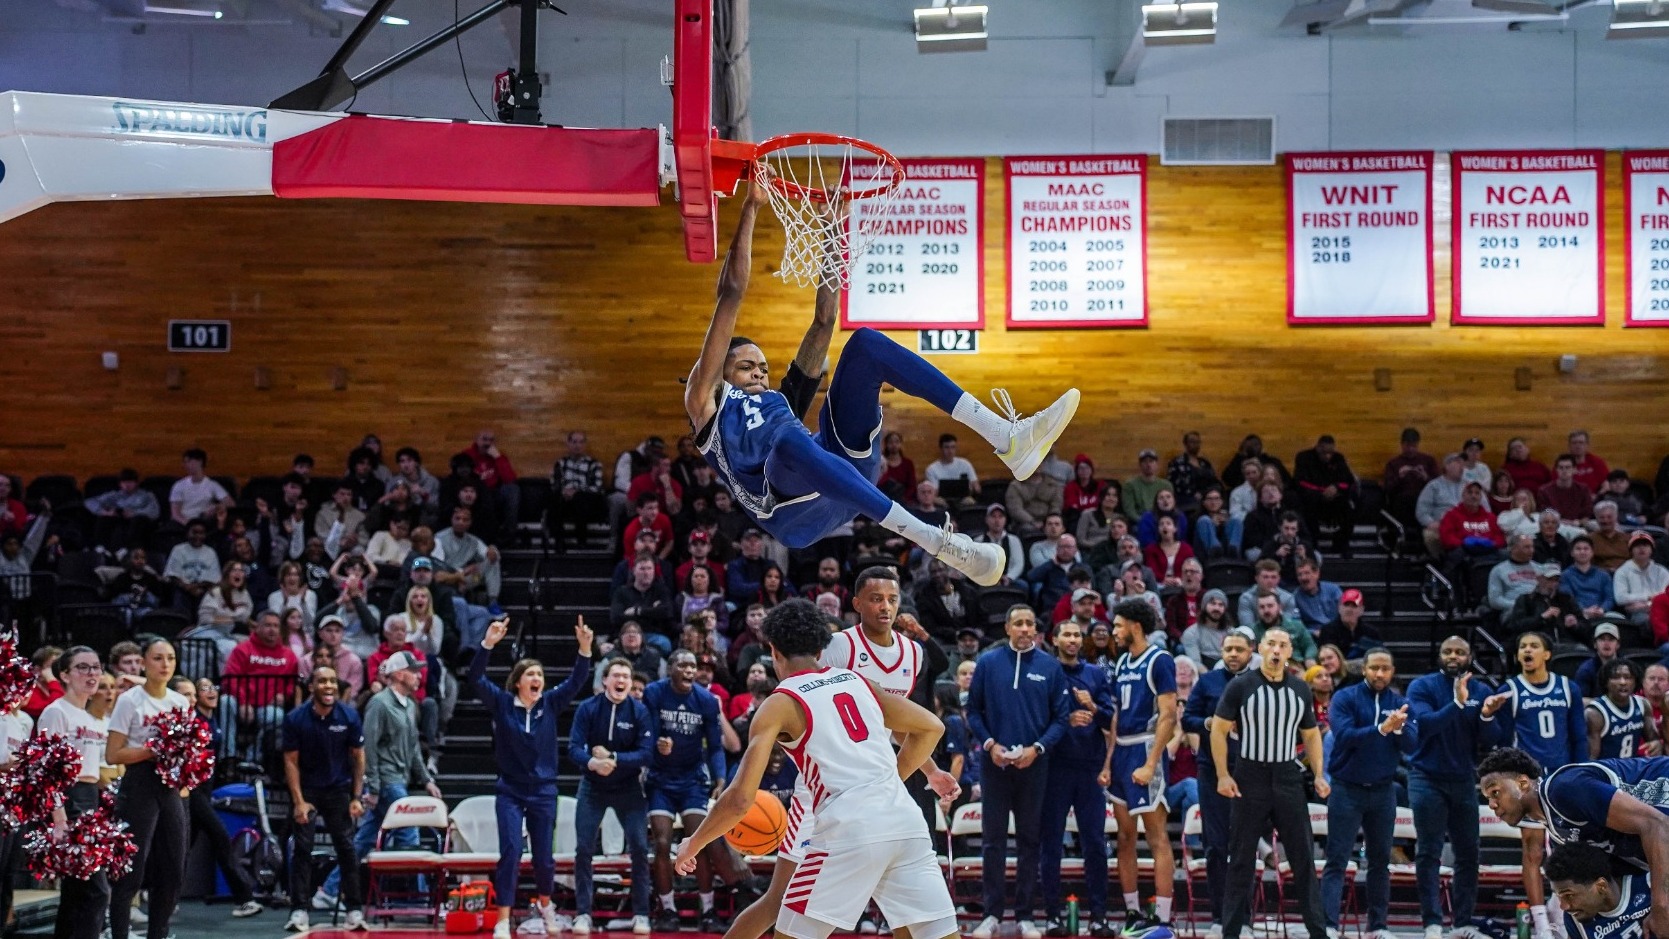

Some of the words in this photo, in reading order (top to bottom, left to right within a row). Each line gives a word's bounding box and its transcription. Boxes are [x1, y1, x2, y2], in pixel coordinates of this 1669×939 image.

[112, 101, 267, 143] SPALDING
[1010, 160, 1067, 173] WOMEN'S
[1069, 159, 1140, 173] BASKETBALL
[1293, 157, 1350, 170] WOMEN'S
[1353, 155, 1426, 169] BASKETBALL
[1461, 156, 1519, 169] WOMEN'S
[1522, 155, 1597, 169] BASKETBALL
[1631, 157, 1669, 170] WOME
[907, 164, 978, 178] BASKETBALL
[1048, 183, 1104, 196] MAAC
[1321, 186, 1398, 205] WNIT
[1486, 186, 1571, 205] NCAA
[919, 204, 966, 215] SEASON
[1023, 201, 1077, 212] REGULAR
[1083, 200, 1129, 210] SEASON
[1021, 215, 1132, 232] CHAMPIONS
[1302, 212, 1352, 228] FIRST
[1358, 211, 1419, 227] ROUND
[1469, 213, 1521, 228] FIRST
[1527, 212, 1589, 228] ROUND
[1029, 241, 1067, 253] 2004
[1086, 240, 1124, 252] 2005
[1311, 236, 1351, 248] 2015
[1479, 236, 1520, 248] 2013
[1538, 236, 1579, 248] 2014
[867, 243, 904, 255] 2012
[921, 243, 960, 255] 2013
[1312, 251, 1352, 263] 2018
[1480, 257, 1520, 268] 2021
[867, 263, 904, 274] 2014
[922, 263, 959, 274] 2020
[1029, 261, 1068, 272] 2006
[1086, 260, 1124, 272] 2007
[867, 283, 906, 294] 2021
[1030, 280, 1068, 292] 2008
[1086, 280, 1125, 292] 2009
[1030, 300, 1069, 312] 2010
[1087, 299, 1125, 311] 2011
[182, 325, 219, 347] 101
[928, 330, 971, 350] 102
[833, 691, 869, 743] 0
[1538, 709, 1555, 739] 0
[1620, 733, 1634, 759] 8
